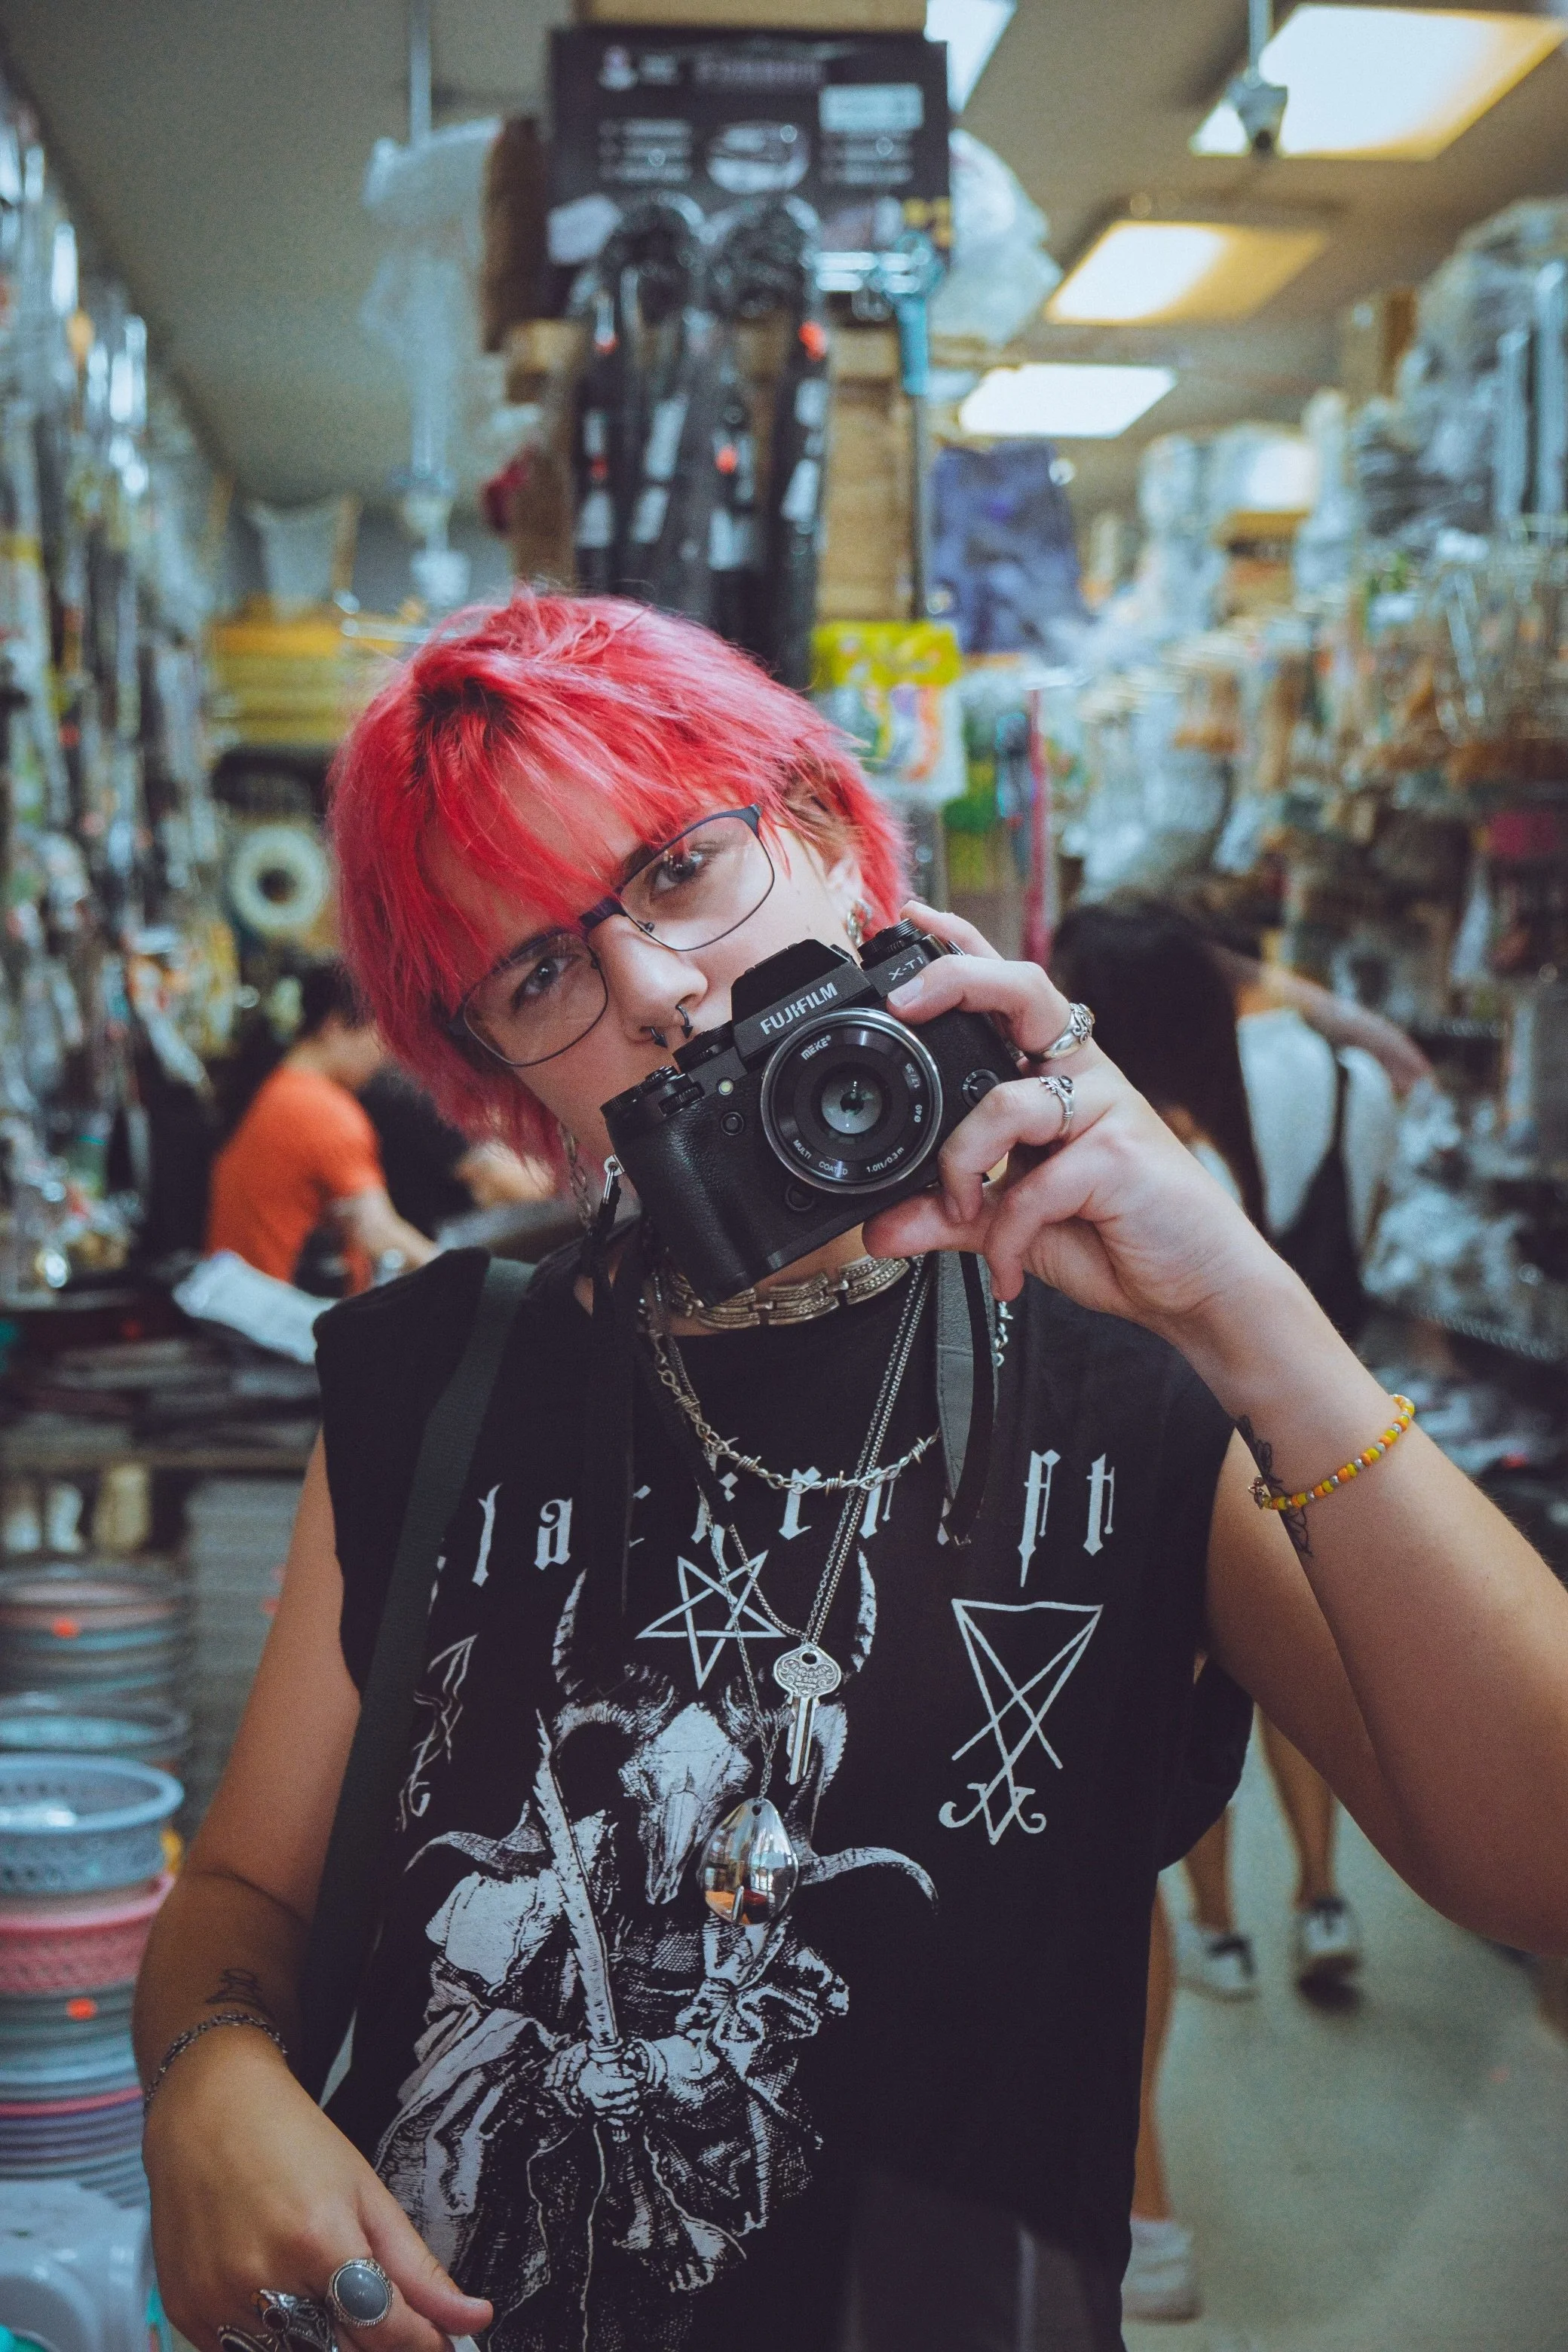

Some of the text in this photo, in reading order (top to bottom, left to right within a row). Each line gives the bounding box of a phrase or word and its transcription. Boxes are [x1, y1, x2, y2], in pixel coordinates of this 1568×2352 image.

[888, 956, 923, 981] X-T1
[760, 982, 838, 1035] FUJIFILM
[793, 1139, 849, 1176] MULTI COATD
